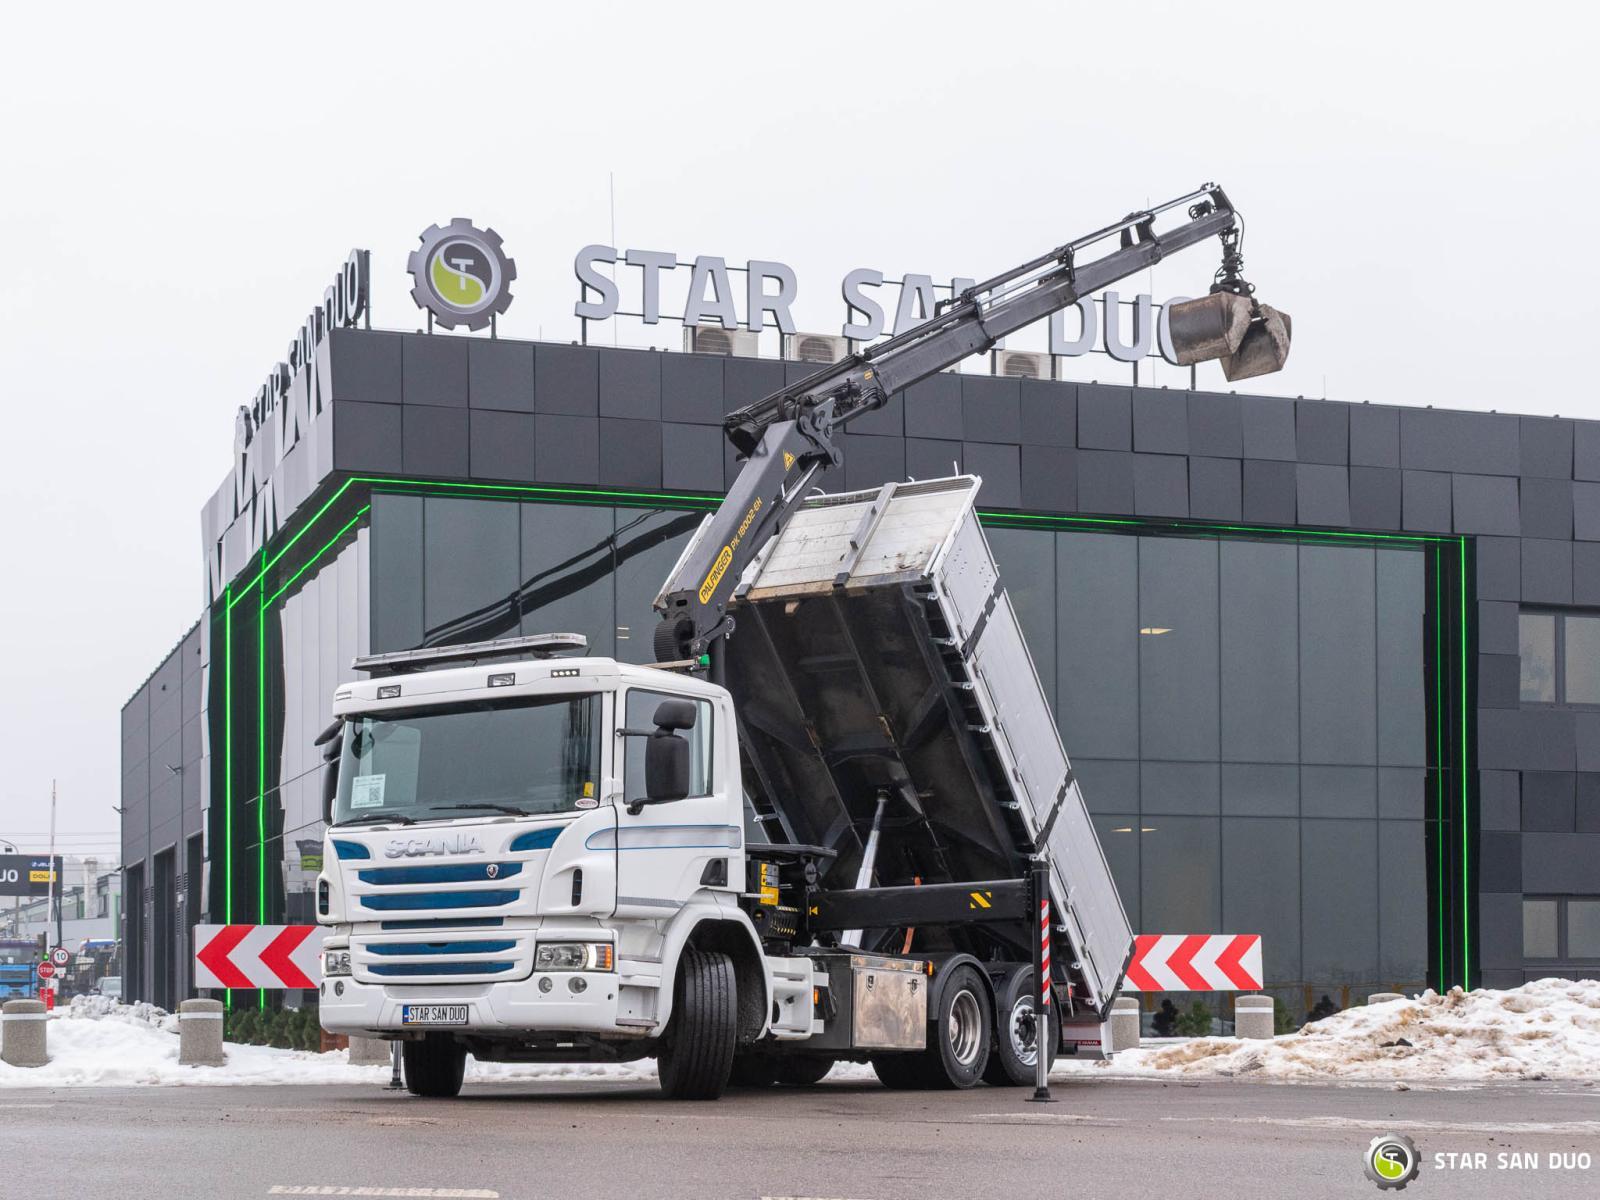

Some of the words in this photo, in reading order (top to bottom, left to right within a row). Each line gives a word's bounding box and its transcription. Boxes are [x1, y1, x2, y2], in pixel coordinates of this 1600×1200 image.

[574, 244, 798, 335] STAR
[700, 550, 731, 600] PALFINGER
[730, 535, 740, 550] PK
[384, 832, 485, 859] SCANIA
[56, 952, 66, 960] 10
[409, 1006, 429, 1021] STAR
[432, 1006, 447, 1021] SAN
[449, 1006, 465, 1021] DUO
